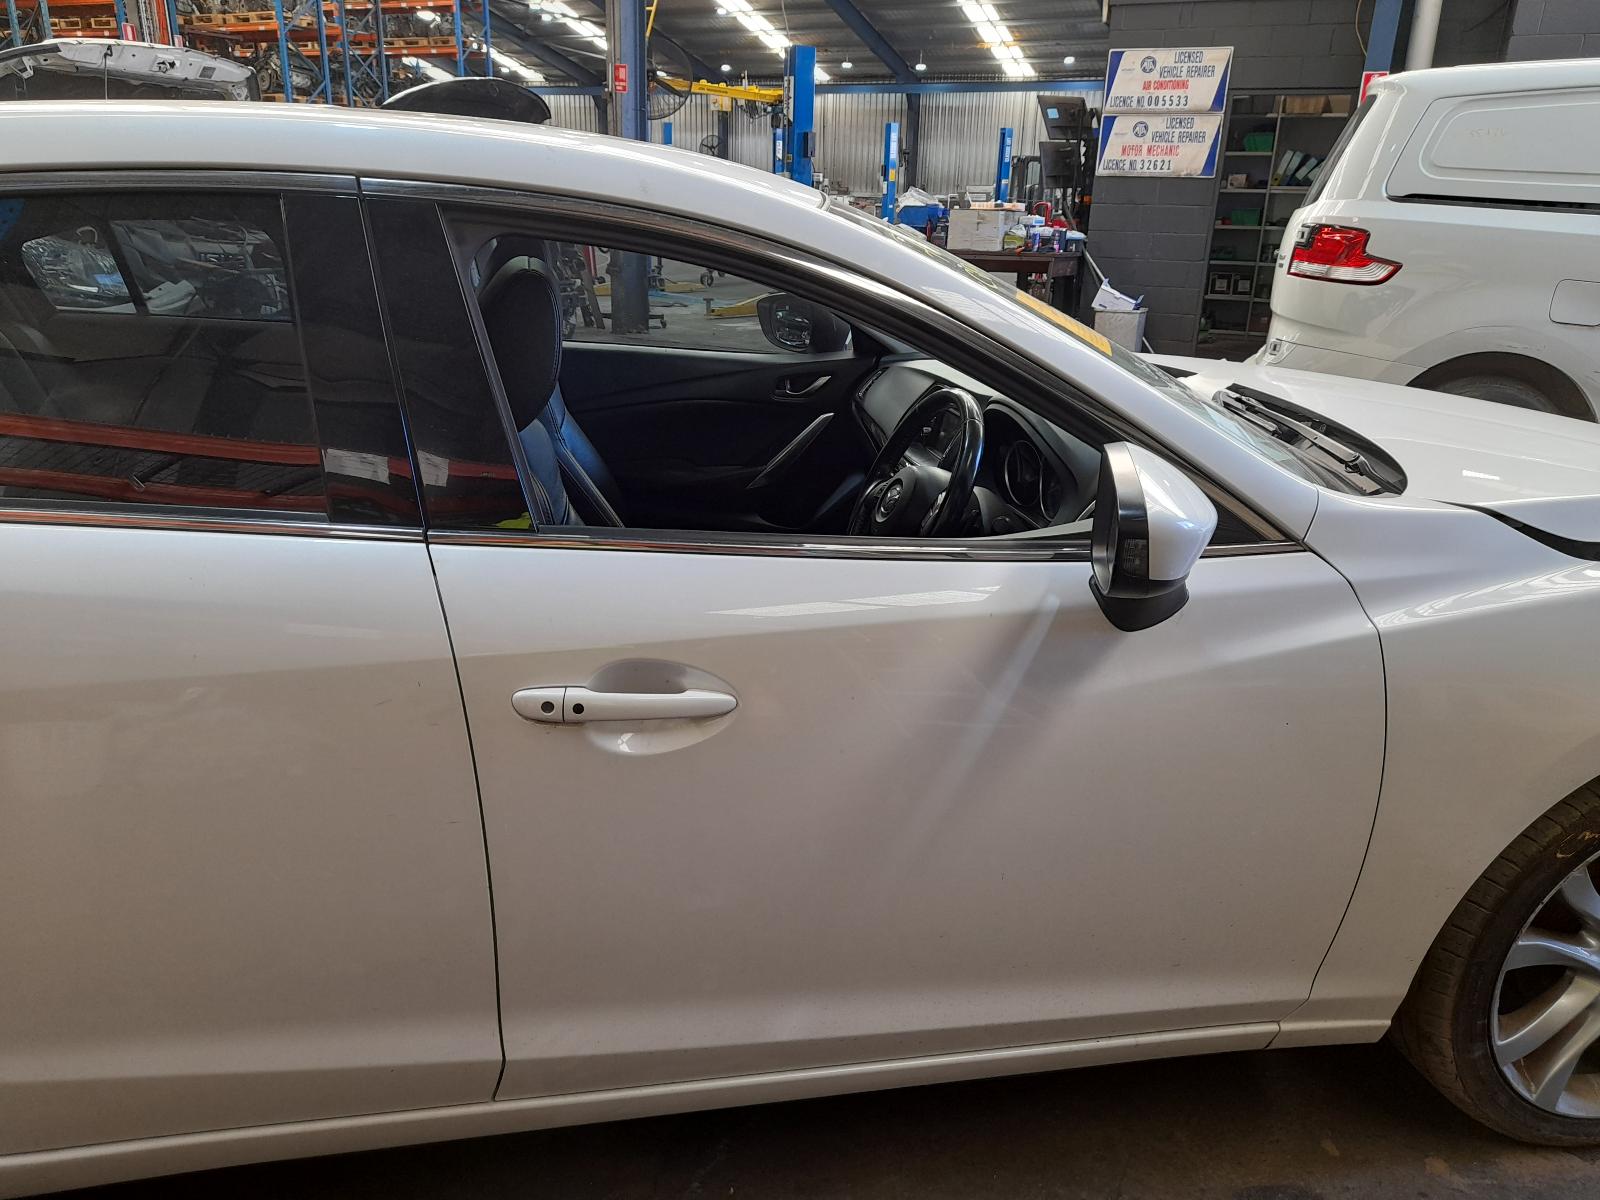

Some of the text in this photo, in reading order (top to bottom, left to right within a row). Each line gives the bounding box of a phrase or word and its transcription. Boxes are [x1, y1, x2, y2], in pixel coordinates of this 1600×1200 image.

[1174, 51, 1204, 64] LICENSED
[1159, 65, 1216, 79] VEHICLE REPAIRER
[1142, 80, 1190, 91] AIR CONDITIONING
[1110, 96, 1134, 108] LICENCE
[1165, 117, 1195, 130] LICENSED
[1151, 130, 1207, 143] VEHICLE REPAIRER
[1121, 144, 1180, 157] MOTOR MECHANIC
[1102, 159, 1127, 171] LICENCE
[1140, 159, 1172, 171] 32621
